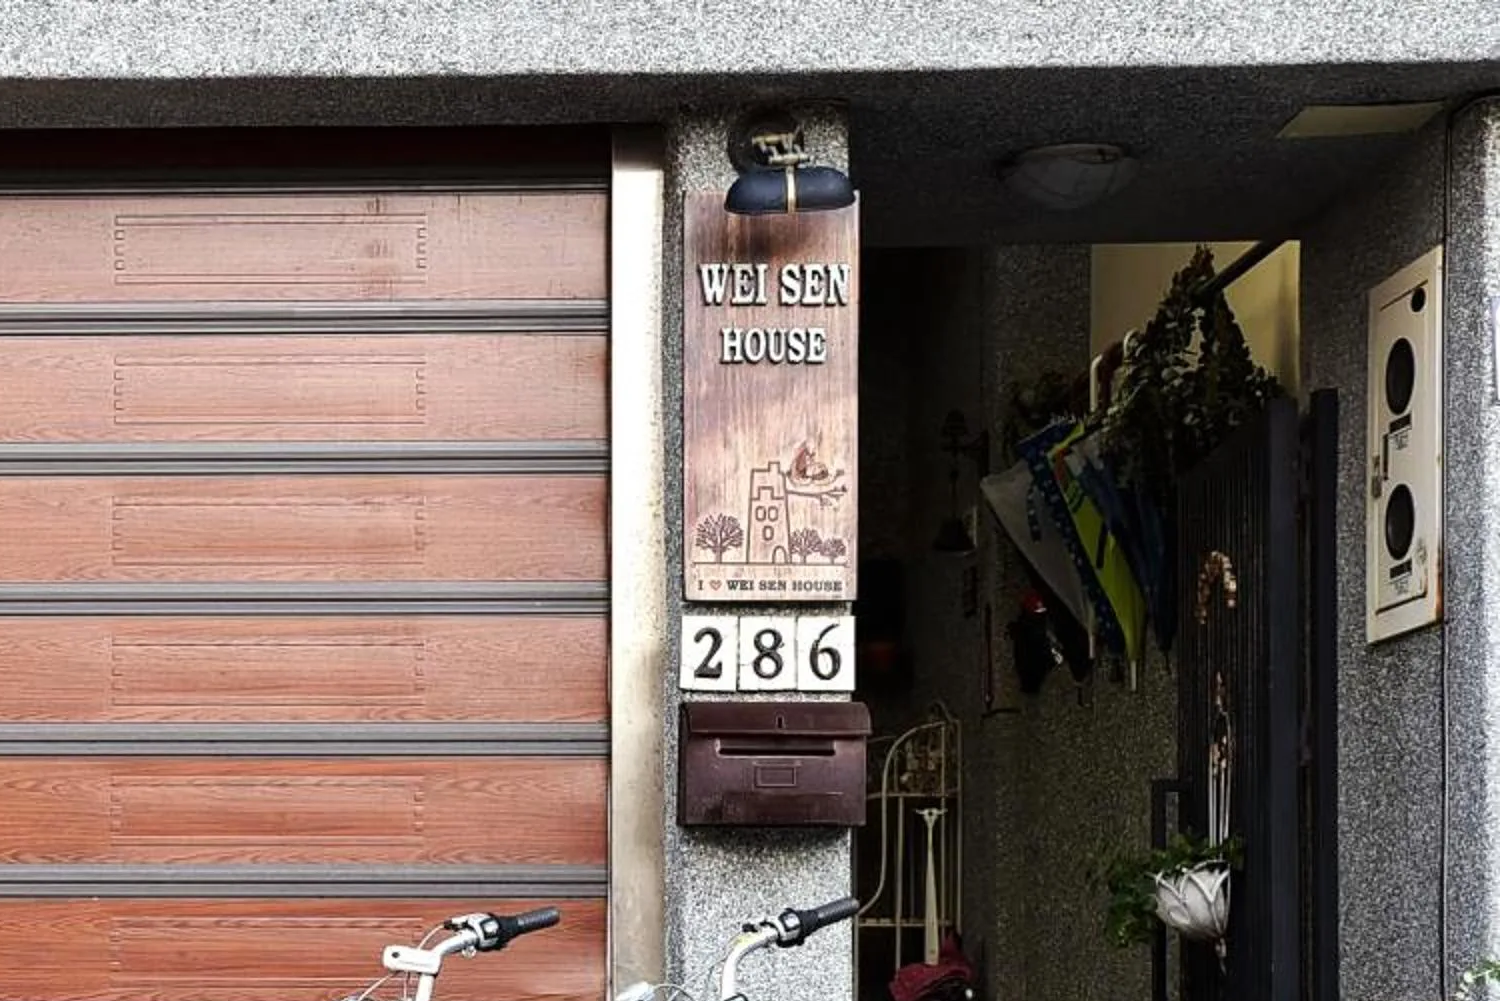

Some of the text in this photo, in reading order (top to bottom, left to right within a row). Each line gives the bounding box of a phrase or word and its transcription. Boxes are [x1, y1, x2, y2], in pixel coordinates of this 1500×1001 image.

[699, 263, 851, 305] WEI SEN
[720, 327, 827, 363] HOUSE
[697, 579, 843, 592] I WEI SEN HOUSE
[694, 623, 841, 681] 286
